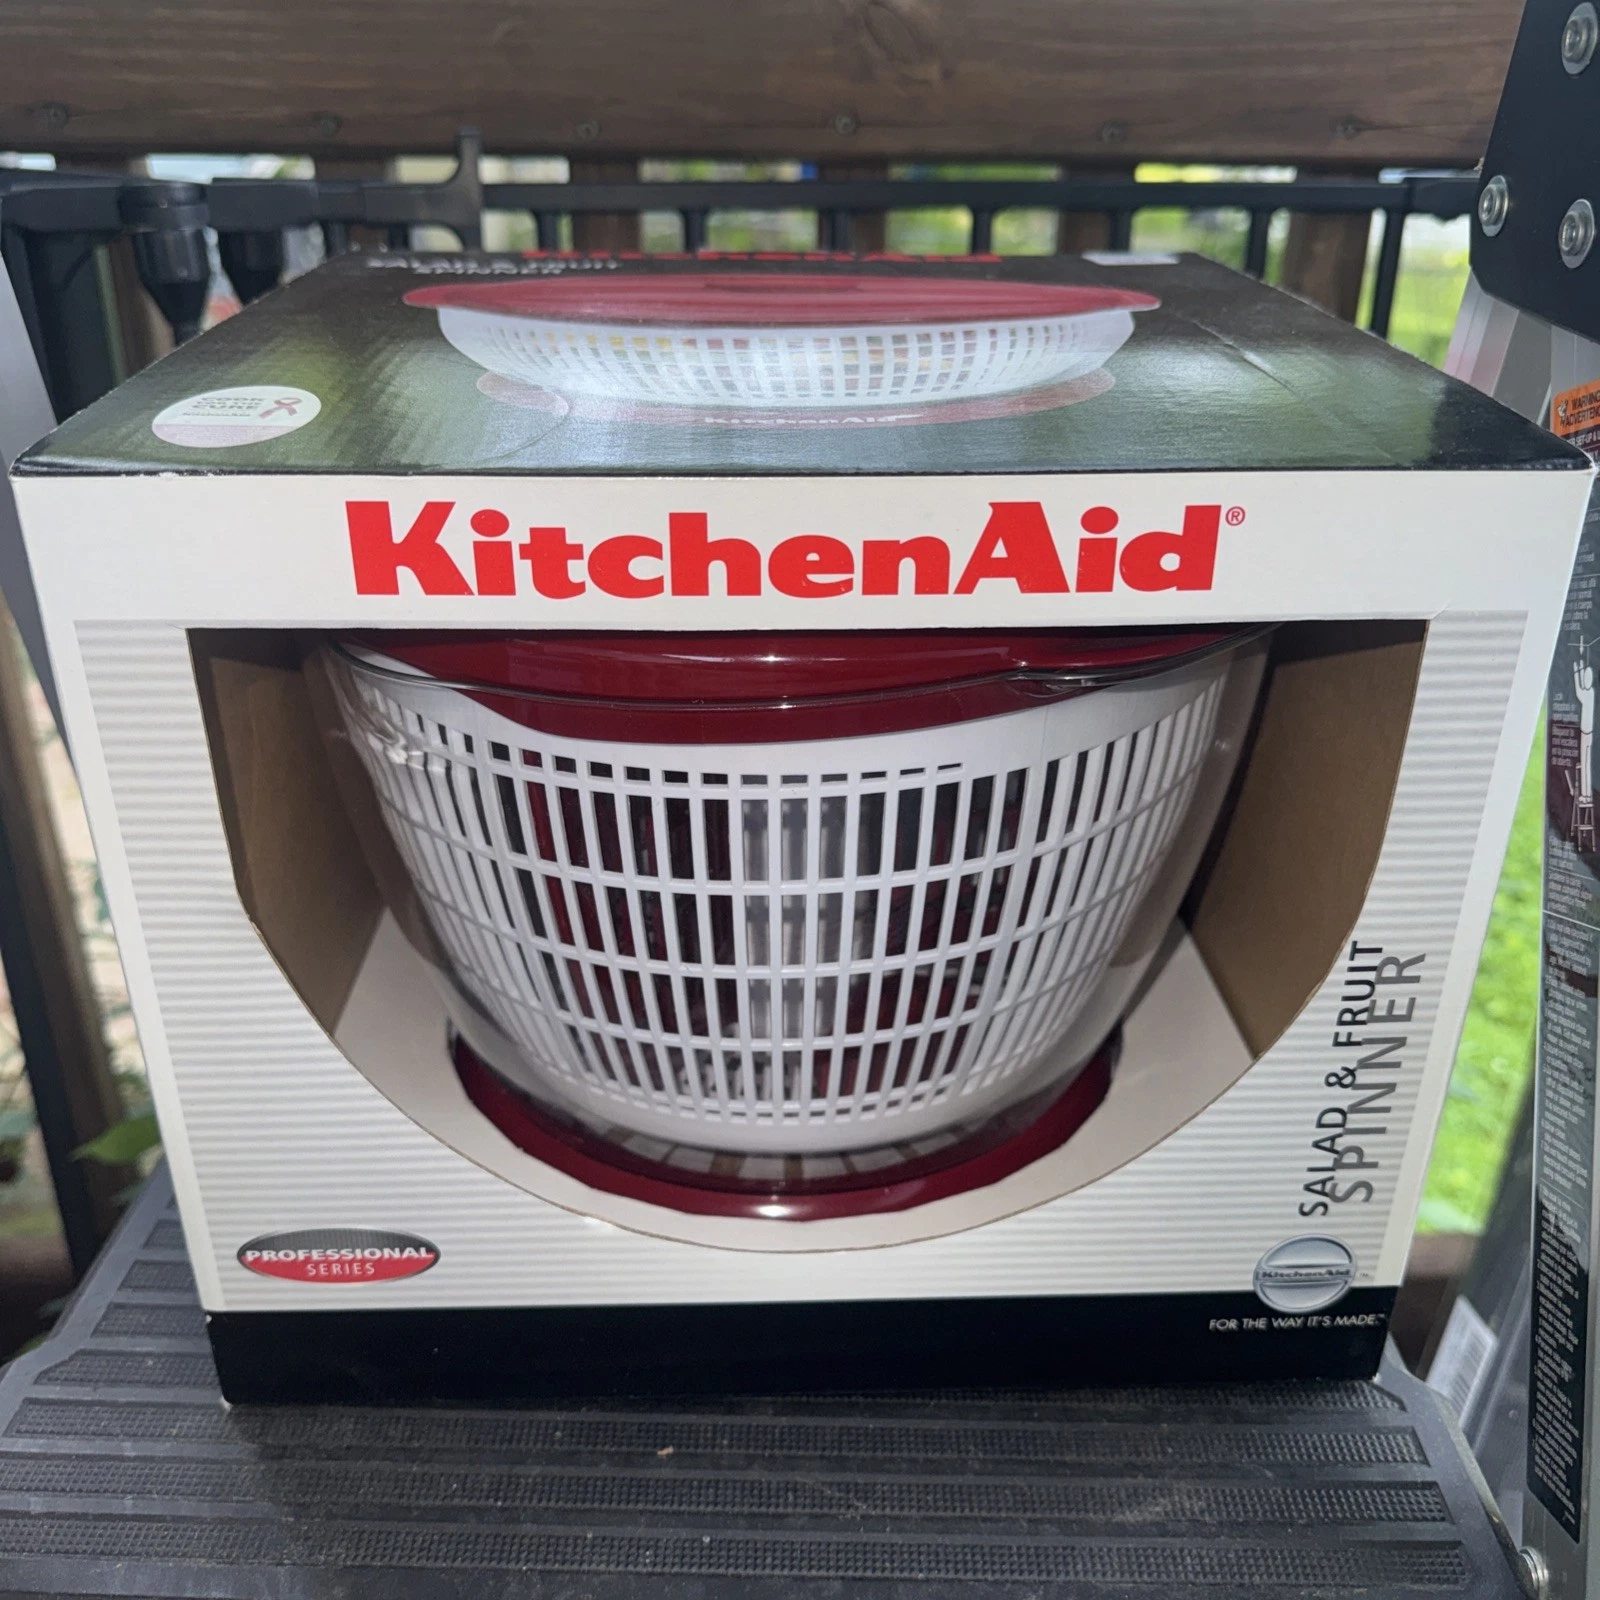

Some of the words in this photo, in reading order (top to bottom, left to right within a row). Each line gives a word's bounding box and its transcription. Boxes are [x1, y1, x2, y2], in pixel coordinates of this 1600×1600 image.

[1331, 940, 1384, 1048] FRUIT
[1324, 1066, 1358, 1090] &
[1328, 952, 1427, 1204] SPINNER
[1298, 1106, 1348, 1217] SALAD
[244, 1246, 436, 1262] PROFESSIONAL
[306, 1262, 376, 1277] SERIES
[1209, 1318, 1239, 1331] FOR
[1242, 1317, 1268, 1329] THE
[1271, 1316, 1304, 1328] WAY
